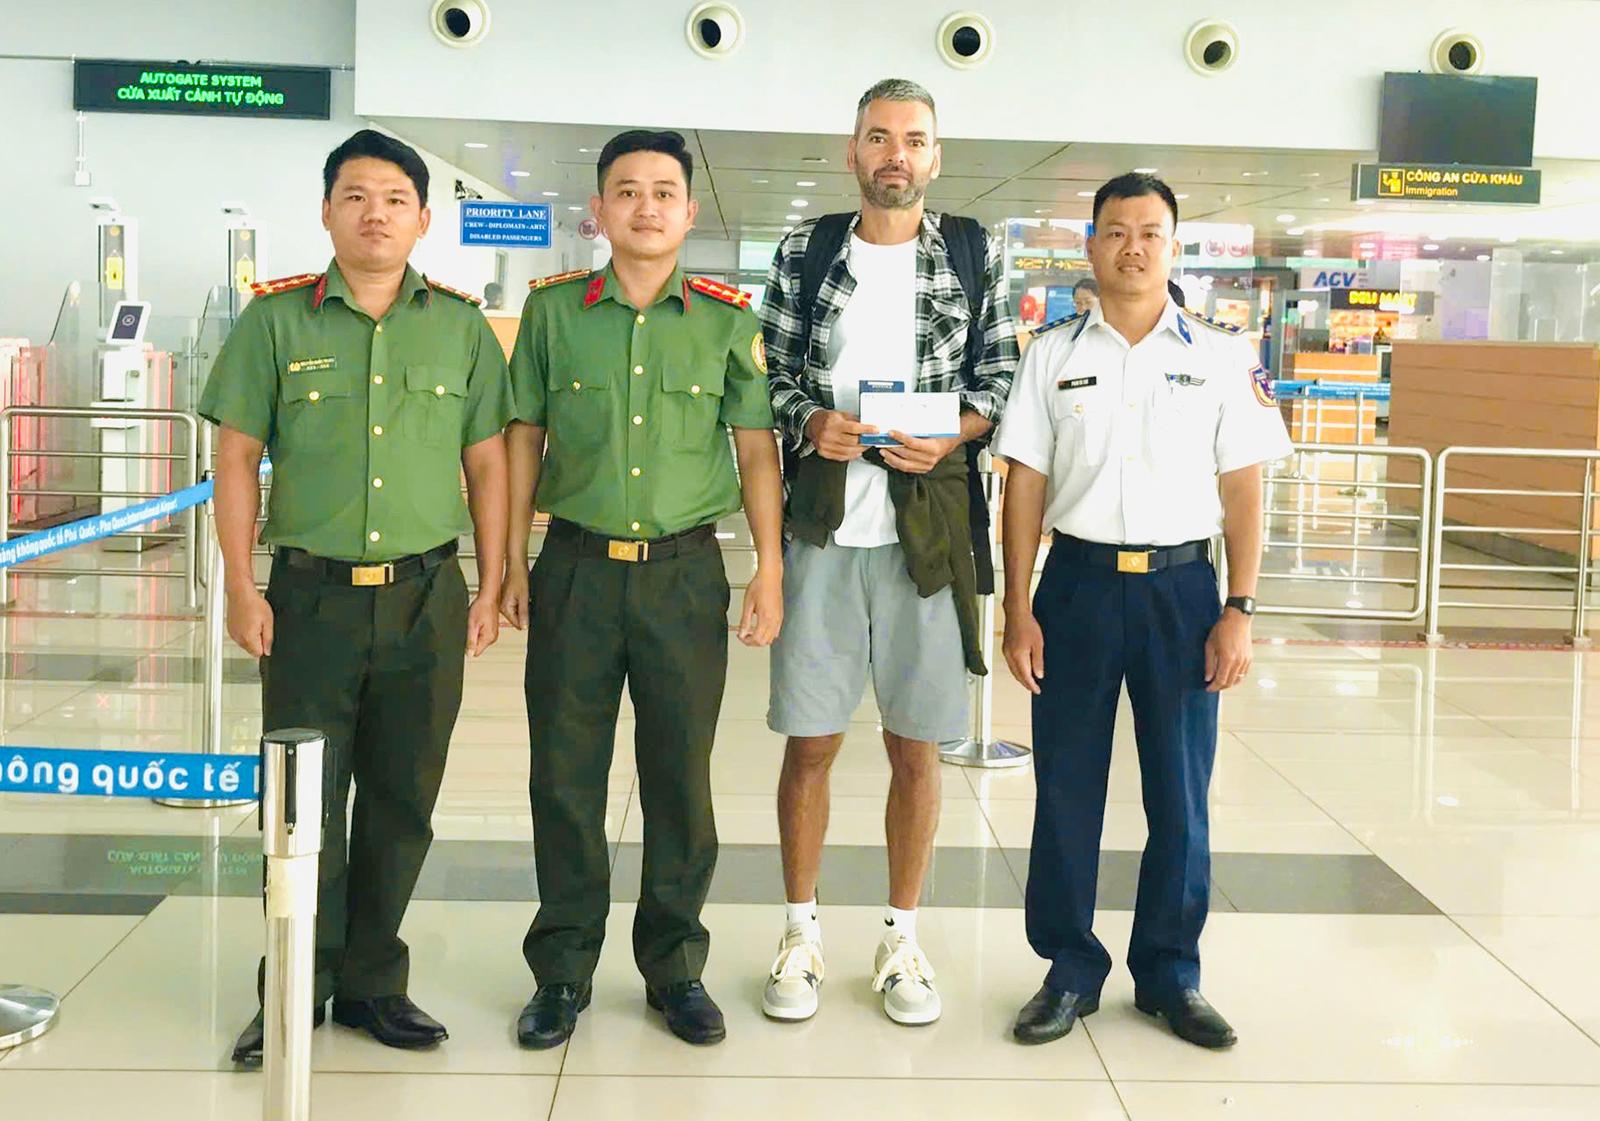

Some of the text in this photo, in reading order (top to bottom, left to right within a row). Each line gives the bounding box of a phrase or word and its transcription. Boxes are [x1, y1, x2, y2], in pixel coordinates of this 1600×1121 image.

[140, 72, 262, 88] AUTOGATE SYSTEM
[117, 85, 145, 100] CỬA
[147, 86, 182, 101] XUẤT
[224, 89, 244, 106] TỰ
[245, 90, 284, 106] ĐỘNG
[1406, 169, 1441, 183] CÔNG
[1443, 172, 1459, 183] AN
[1462, 171, 1488, 184] CỬA
[1405, 186, 1458, 198] Immigration
[466, 208, 546, 219] PRIORITY LANE
[502, 234, 542, 242] PASSENGERS
[1313, 271, 1356, 287] ACV
[92, 758, 188, 794] quốc
[203, 761, 242, 792] tế
